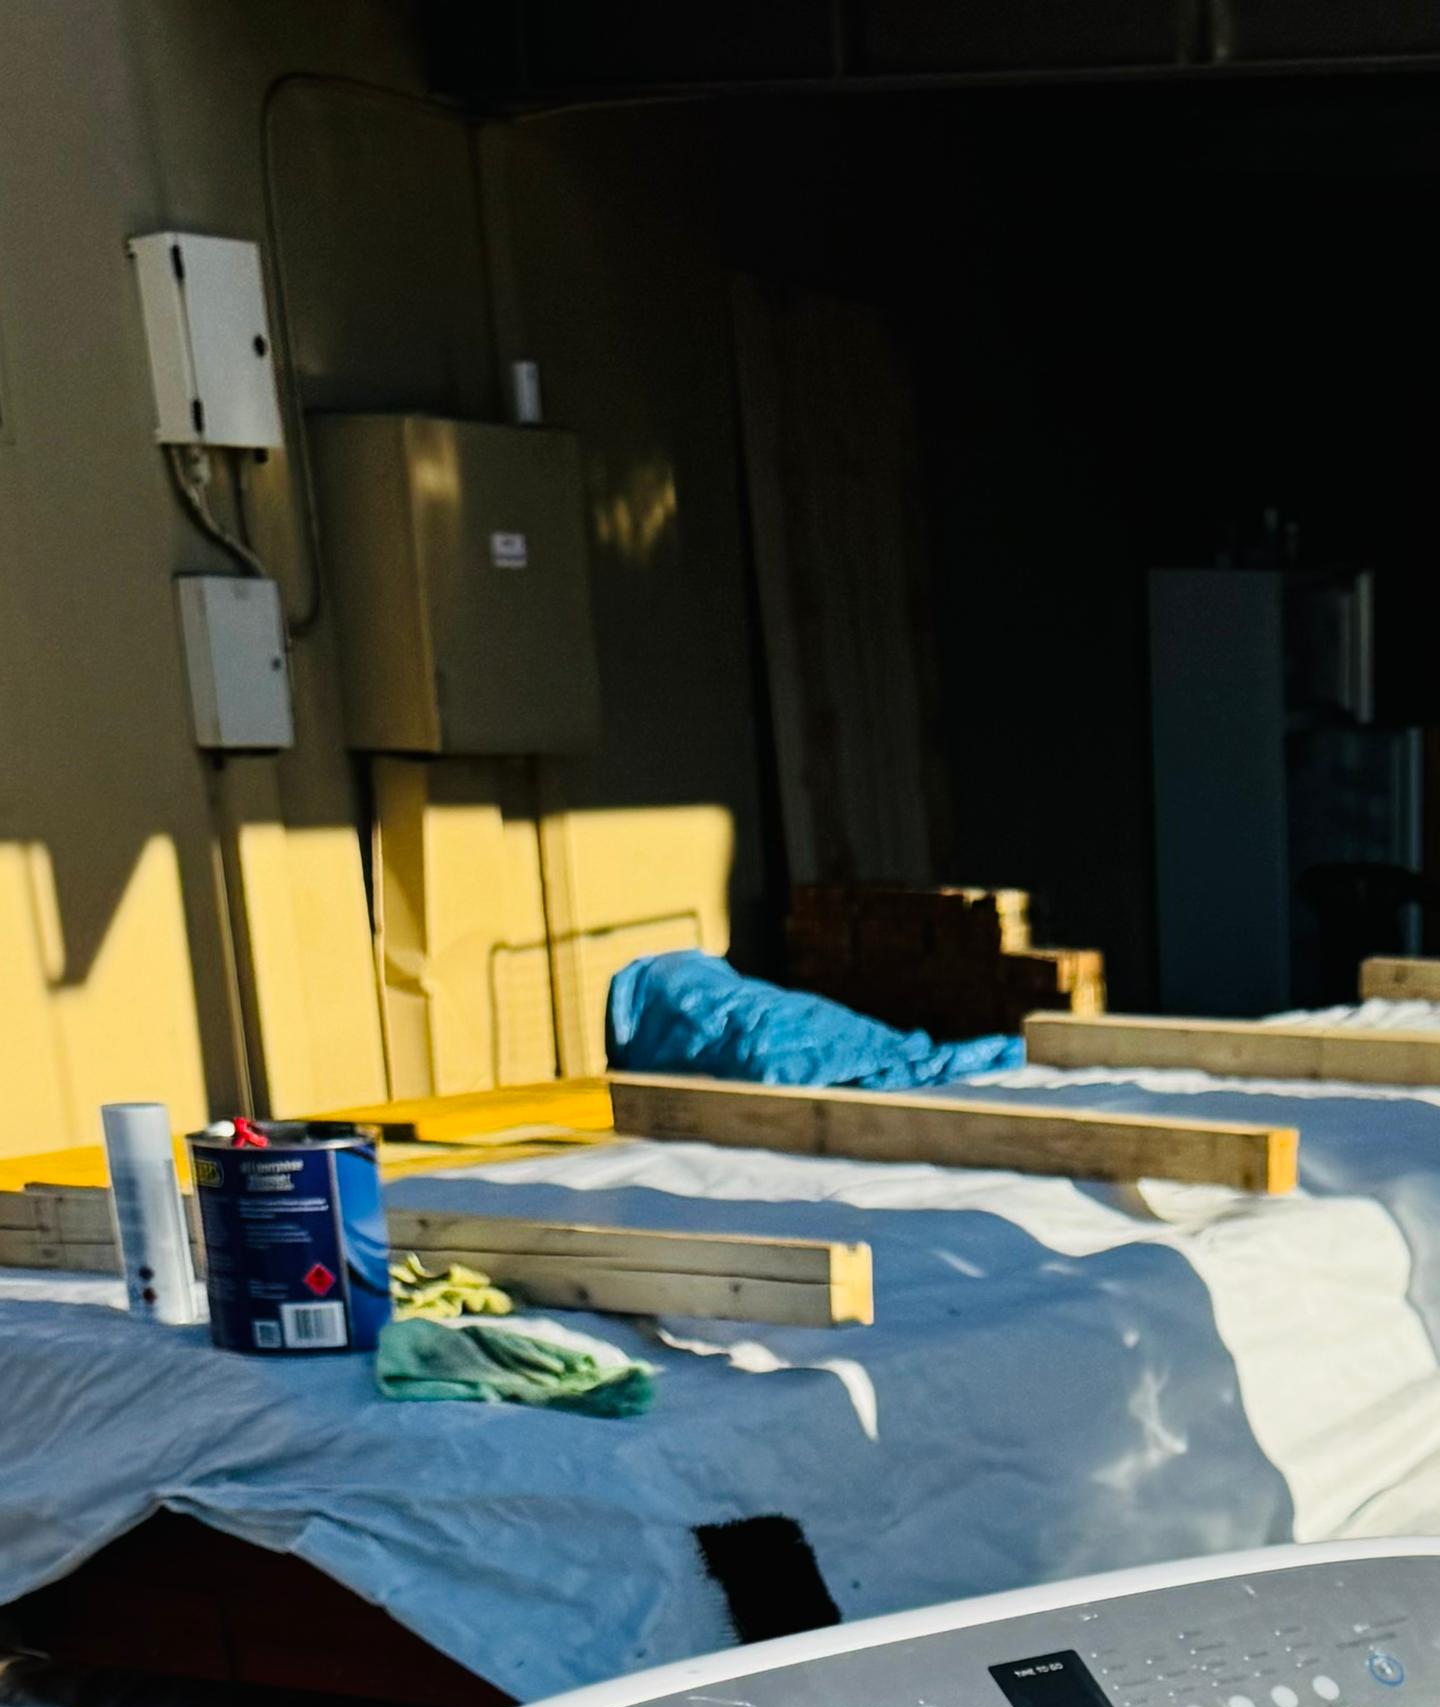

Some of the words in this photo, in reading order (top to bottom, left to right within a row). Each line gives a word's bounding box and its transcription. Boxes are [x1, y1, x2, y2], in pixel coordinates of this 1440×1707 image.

[1014, 1667, 1036, 1678] TIME
[1037, 1665, 1050, 1674] TO
[1050, 1662, 1063, 1671] GO
